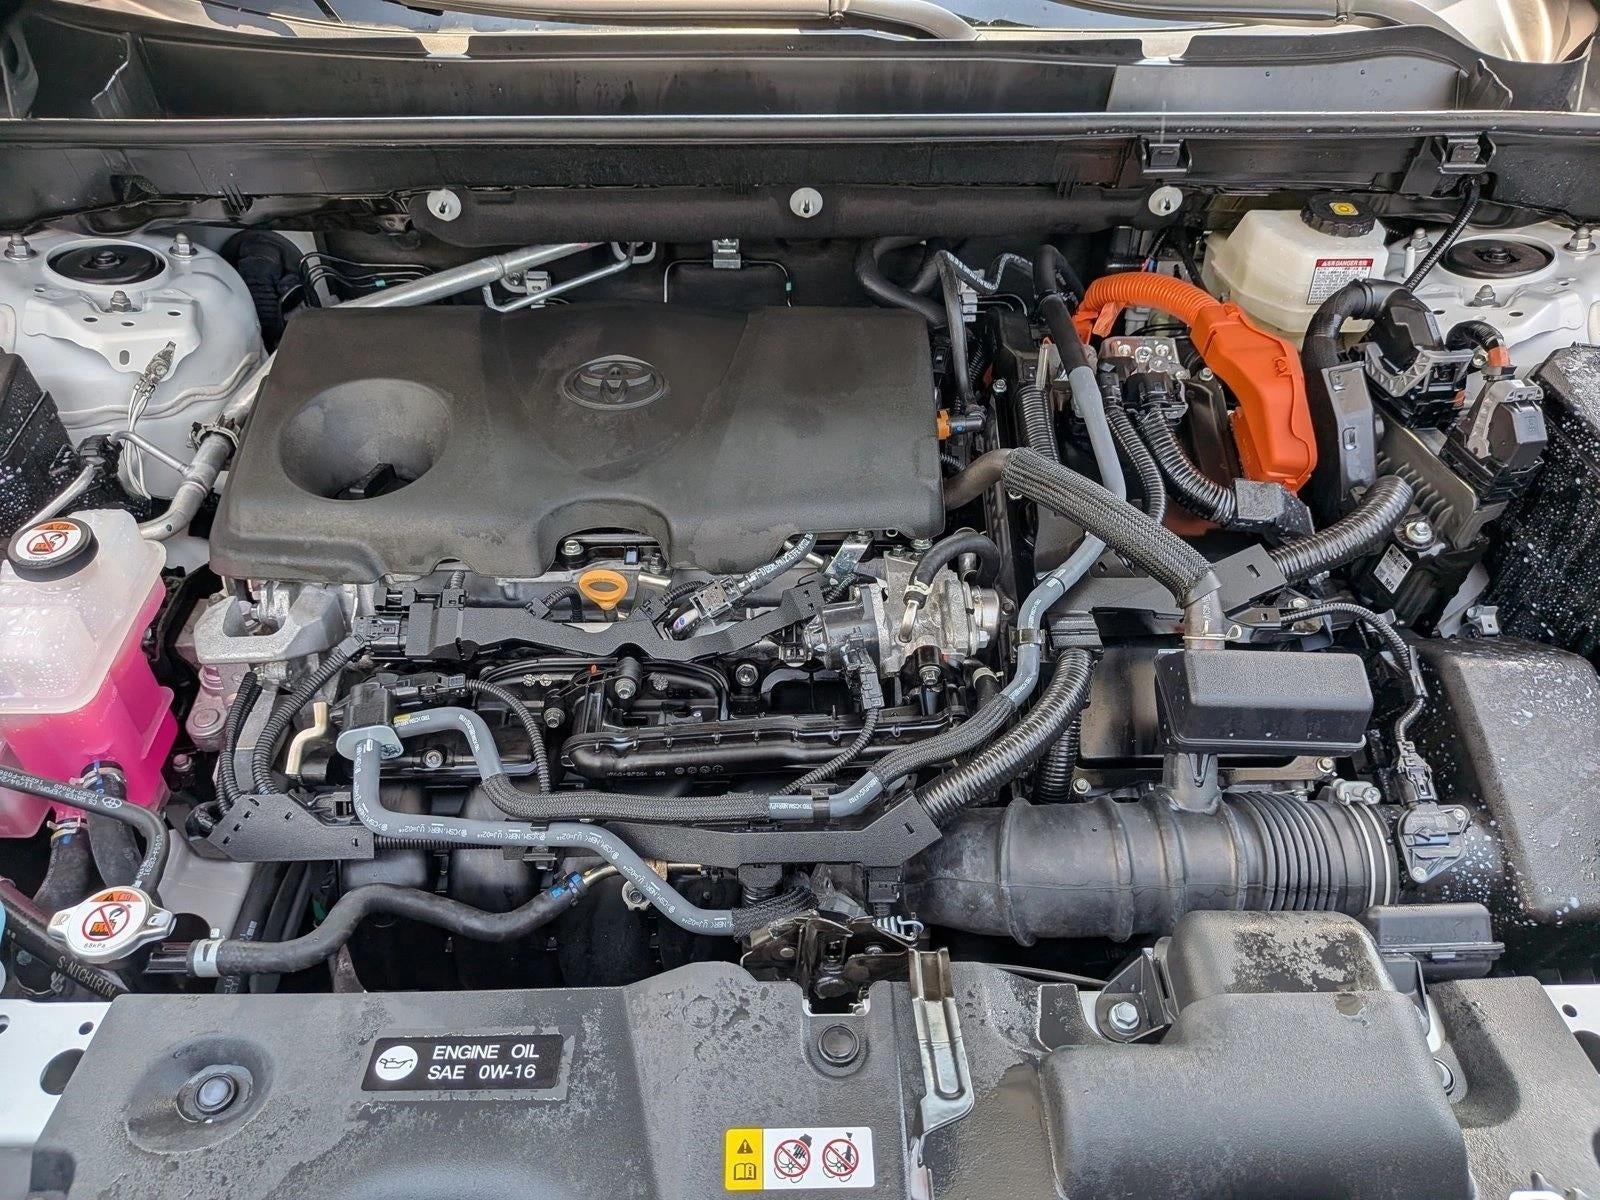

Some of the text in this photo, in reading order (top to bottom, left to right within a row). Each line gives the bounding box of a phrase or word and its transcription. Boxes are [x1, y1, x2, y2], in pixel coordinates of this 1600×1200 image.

[432, 1043, 540, 1060] ENGINE OIL
[427, 1063, 536, 1080] SAE 0W-16
